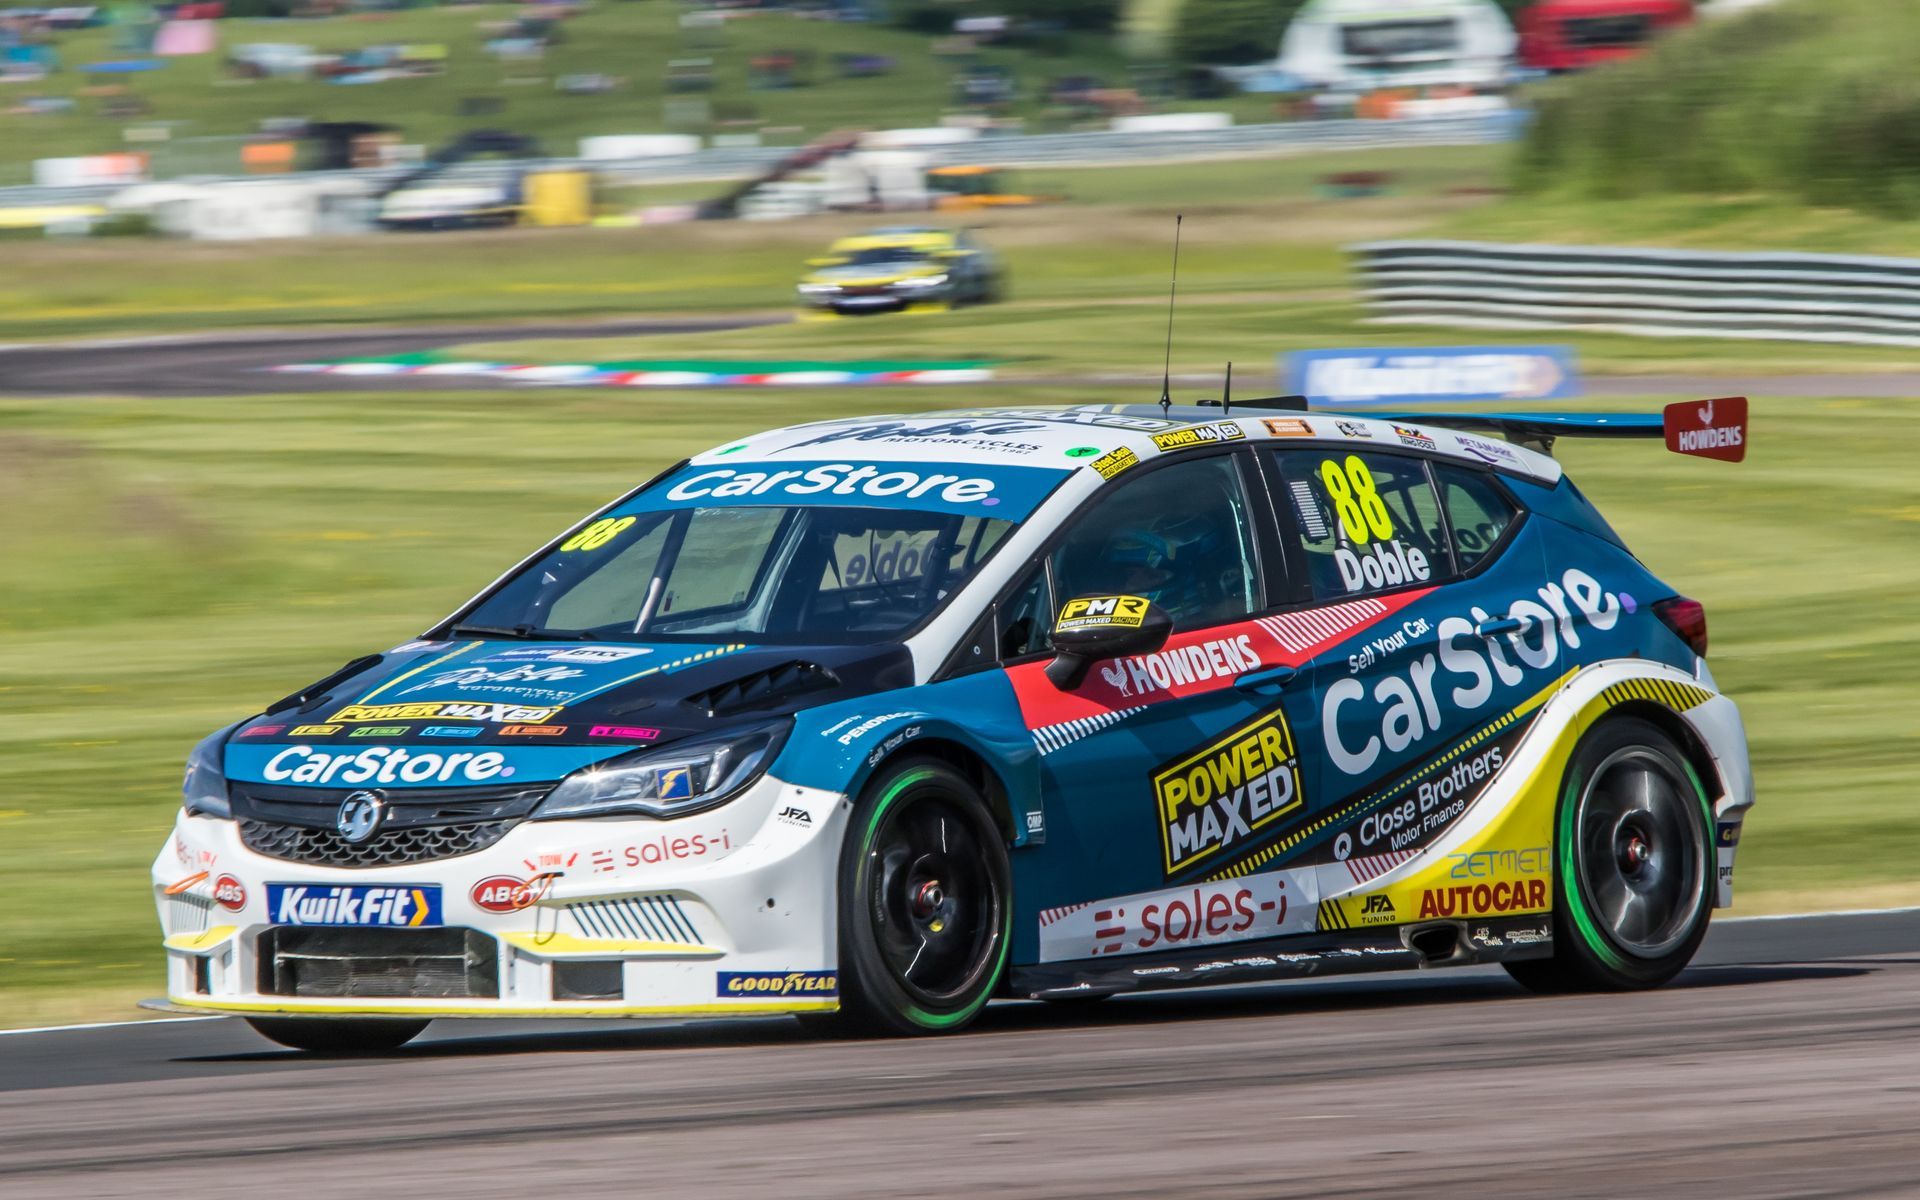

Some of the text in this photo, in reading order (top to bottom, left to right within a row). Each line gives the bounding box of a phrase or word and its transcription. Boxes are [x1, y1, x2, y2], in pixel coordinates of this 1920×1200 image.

[883, 437, 1042, 452] MOTORCYCLES
[1157, 421, 1241, 448] POWER MAXED
[1678, 425, 1743, 451] HOWDENS
[1090, 446, 1132, 472] Steel Seal
[1320, 455, 1393, 545] 88
[559, 516, 637, 553] 88
[1334, 539, 1431, 592] Doble
[1064, 598, 1144, 618] PMR
[1060, 619, 1085, 629] POWER
[1085, 617, 1112, 625] MAXED
[1126, 635, 1261, 694] HOWDENS
[1348, 645, 1376, 674] Sell
[1372, 630, 1408, 657] Your
[456, 685, 578, 698] MOTORCYCLES
[344, 703, 549, 723] POWER MAXED
[869, 746, 885, 768] Sell
[883, 732, 904, 751] Your
[1163, 726, 1288, 822] POWER
[1359, 747, 1504, 847] Close Brothers
[778, 806, 812, 823] JFA
[1027, 814, 1043, 829] OMP
[1169, 765, 1294, 863] MAXED
[1391, 799, 1465, 852] Motor Finance
[538, 854, 562, 866] TOW
[624, 828, 730, 867] sales-i
[216, 884, 243, 903] ABS
[1360, 894, 1396, 914] JFA
[1419, 879, 1547, 919] AUTOCAR
[1138, 880, 1288, 948] sales-i
[1361, 914, 1396, 923] TUNING
[728, 975, 838, 993] GOODYEAR
